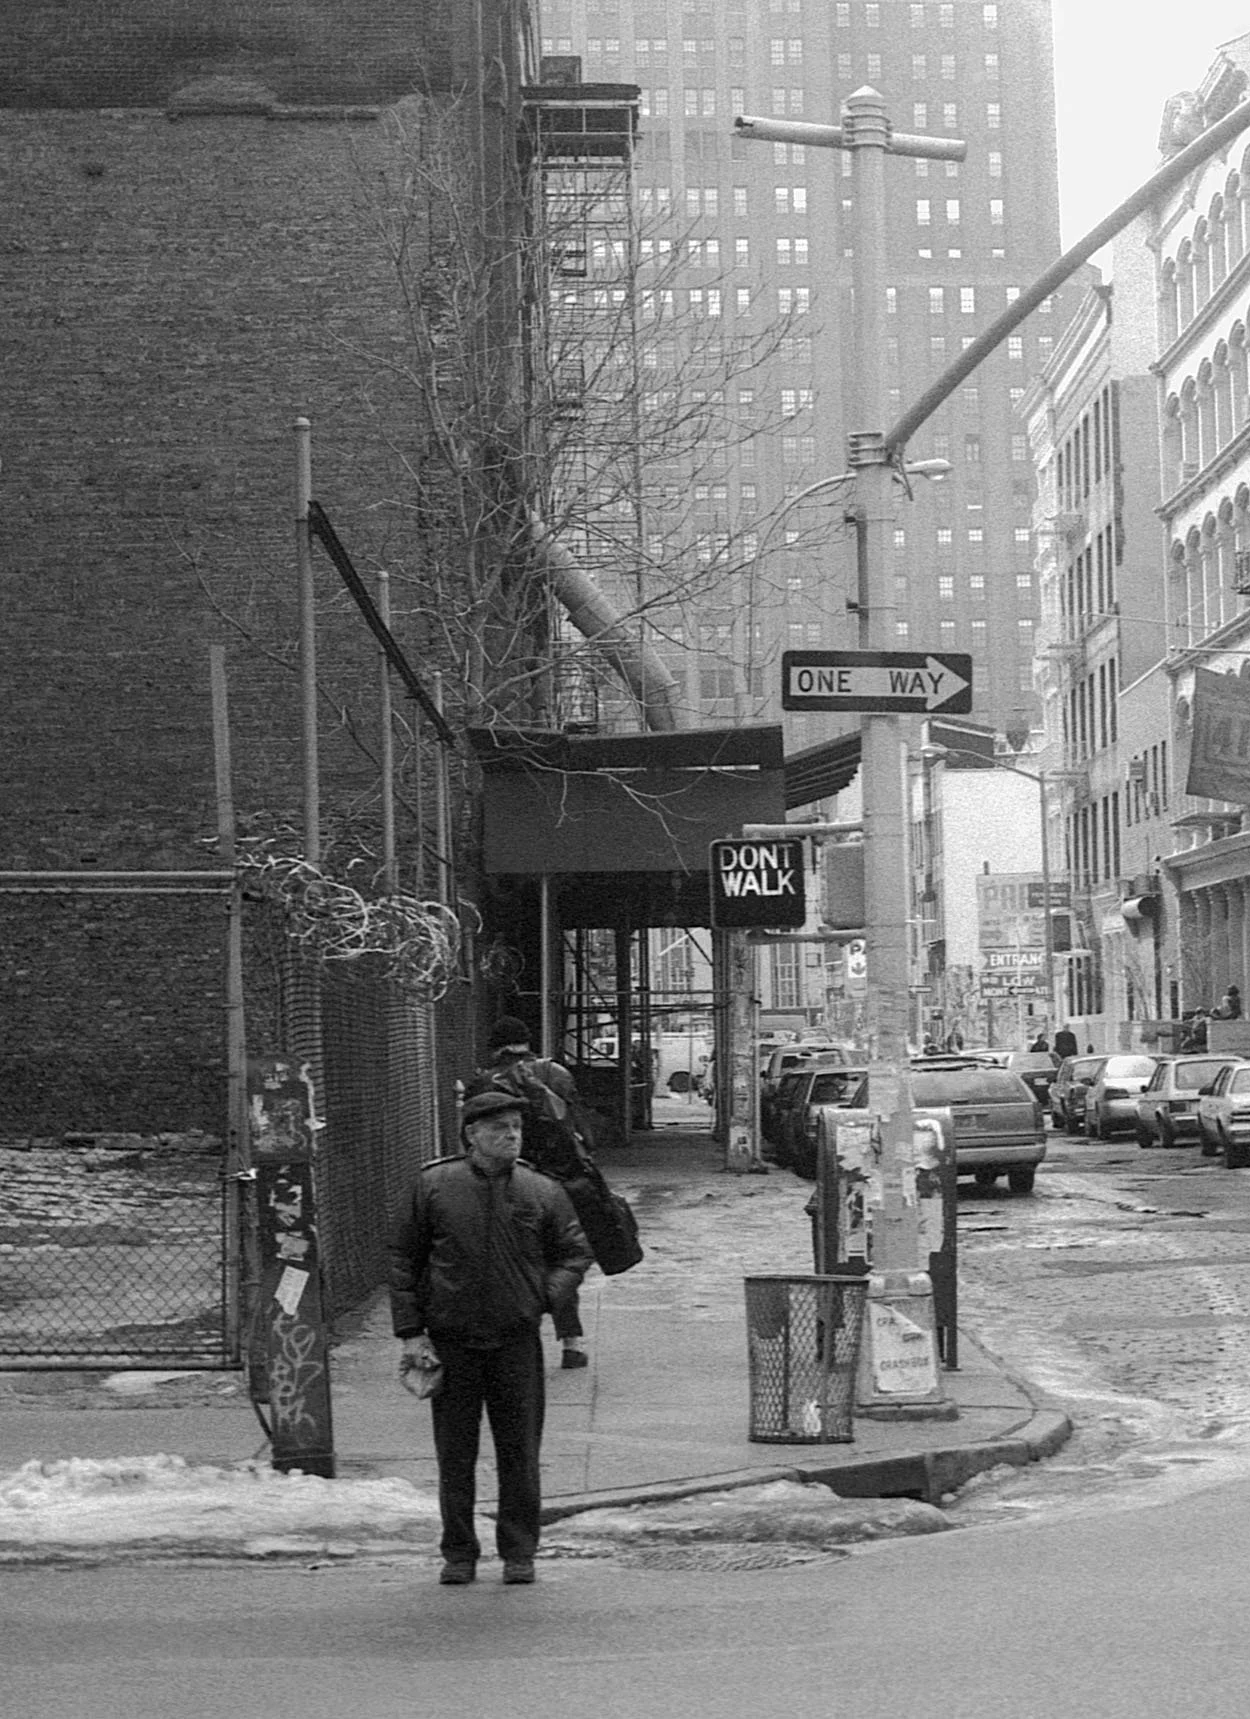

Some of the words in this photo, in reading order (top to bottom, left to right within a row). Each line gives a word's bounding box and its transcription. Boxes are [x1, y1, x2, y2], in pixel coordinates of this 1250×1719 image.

[797, 669, 852, 693] ONE
[889, 670, 945, 695] WAY
[719, 843, 794, 871] DONT
[720, 869, 797, 897] WALK
[989, 952, 1047, 967] ENTRANC
